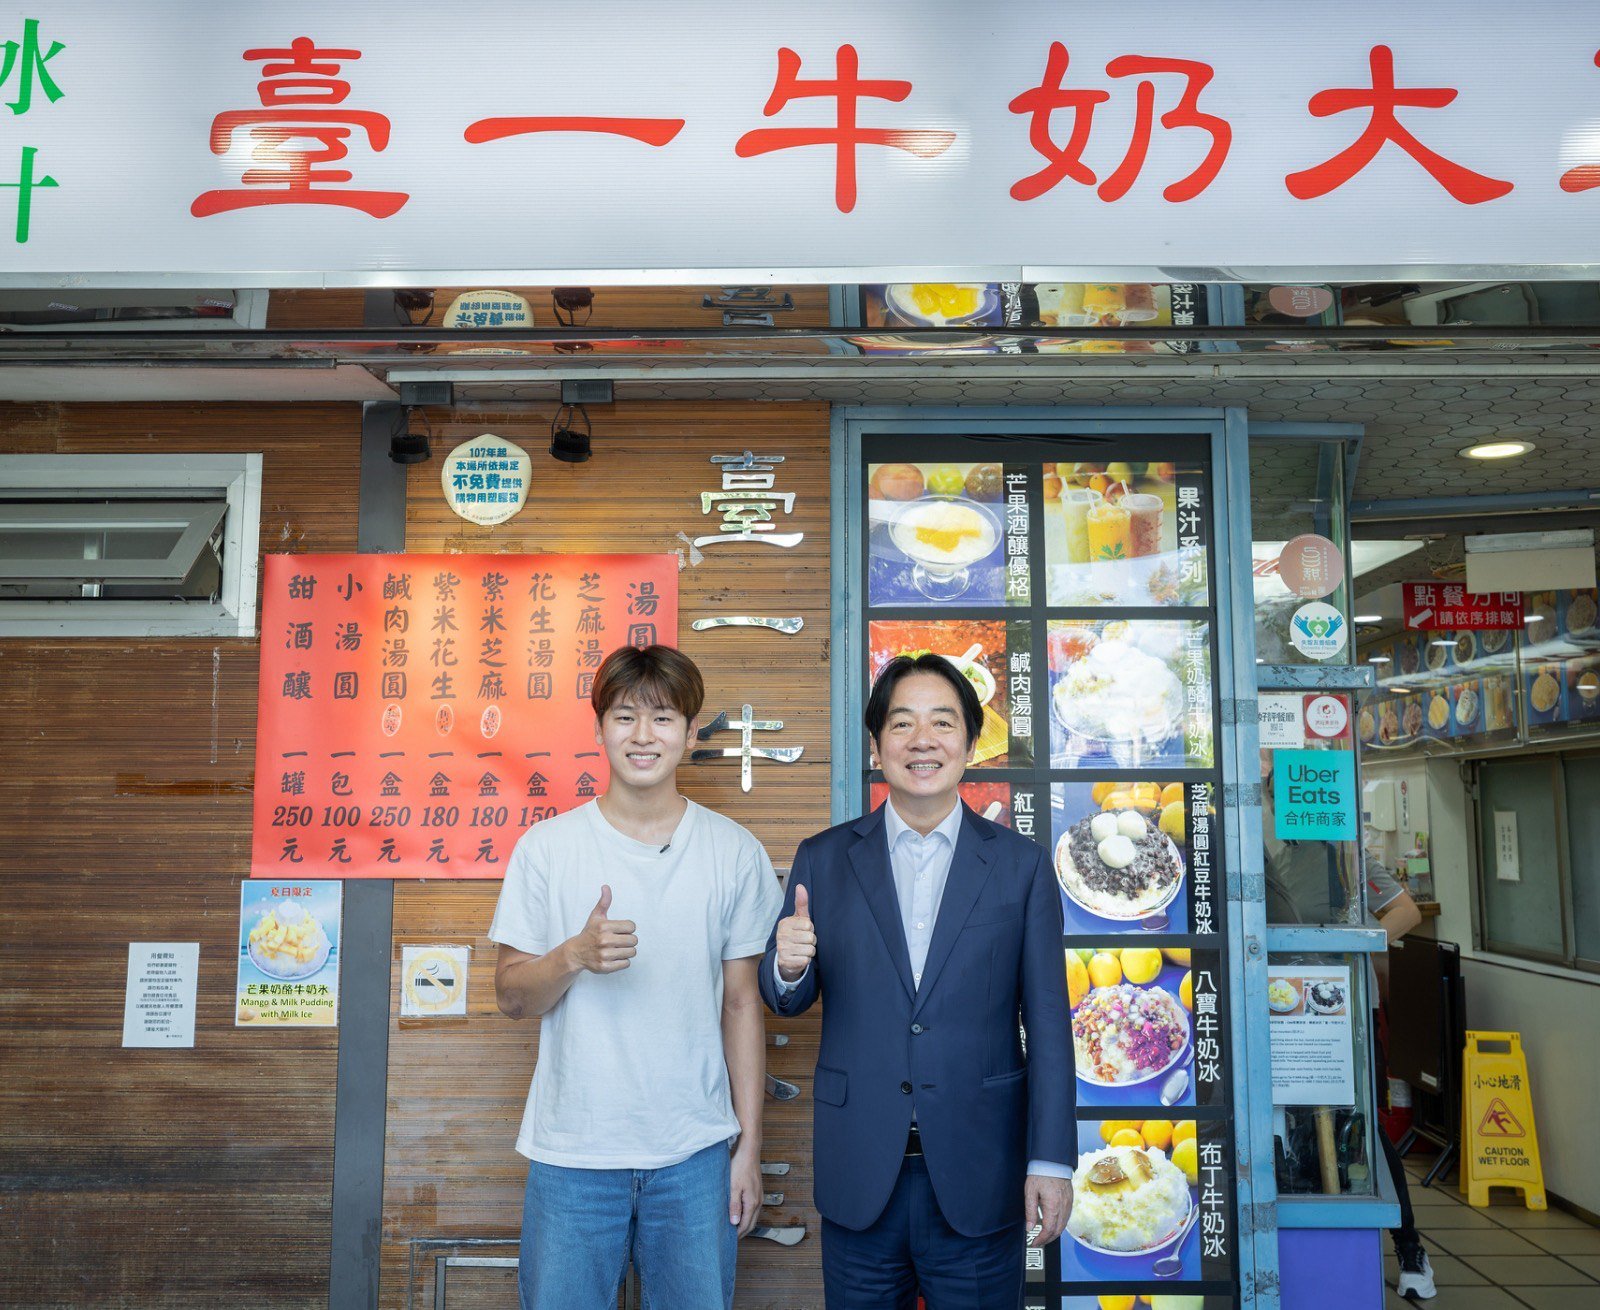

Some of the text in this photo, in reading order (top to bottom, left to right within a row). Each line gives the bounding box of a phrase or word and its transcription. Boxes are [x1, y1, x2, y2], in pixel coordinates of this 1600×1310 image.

[191, 36, 1600, 219] 臺一牛奶大
[453, 473, 522, 490] 不免費提供
[469, 447, 507, 458] 107年起
[1006, 473, 1030, 598] 芒果酒釀優格
[1177, 486, 1203, 583] 果汁系列
[282, 574, 317, 700] 甜酒釀
[333, 573, 364, 699] 小湯圓
[381, 572, 412, 700] 鹹肉湯圓
[429, 572, 460, 701] 紫米花生
[476, 572, 509, 701] 紫米芝麻
[526, 573, 557, 700] 花生湯圓
[1439, 611, 1515, 626] 請依序排隊
[1010, 651, 1032, 738] 鹹肉湯圓
[1185, 631, 1208, 757] 芒果奶酪牛奶冰
[1013, 791, 1035, 842] 紅豆
[1284, 810, 1347, 827] 合作商家
[1288, 764, 1340, 783] Uber
[1288, 785, 1341, 805] Eats
[1191, 783, 1213, 935] 芝麻湯圓紅豆牛奶冰
[240, 998, 334, 1008] Mango & Milk Pudding
[261, 1010, 313, 1018] with Milk Ice
[1195, 970, 1221, 1083] 八寶牛奶冰
[1473, 1074, 1522, 1091] 小心地滑
[1478, 1156, 1530, 1166] WET FLOOR
[1484, 1146, 1524, 1156] CAUTION
[1200, 1142, 1227, 1258] 布丁牛奶冰
